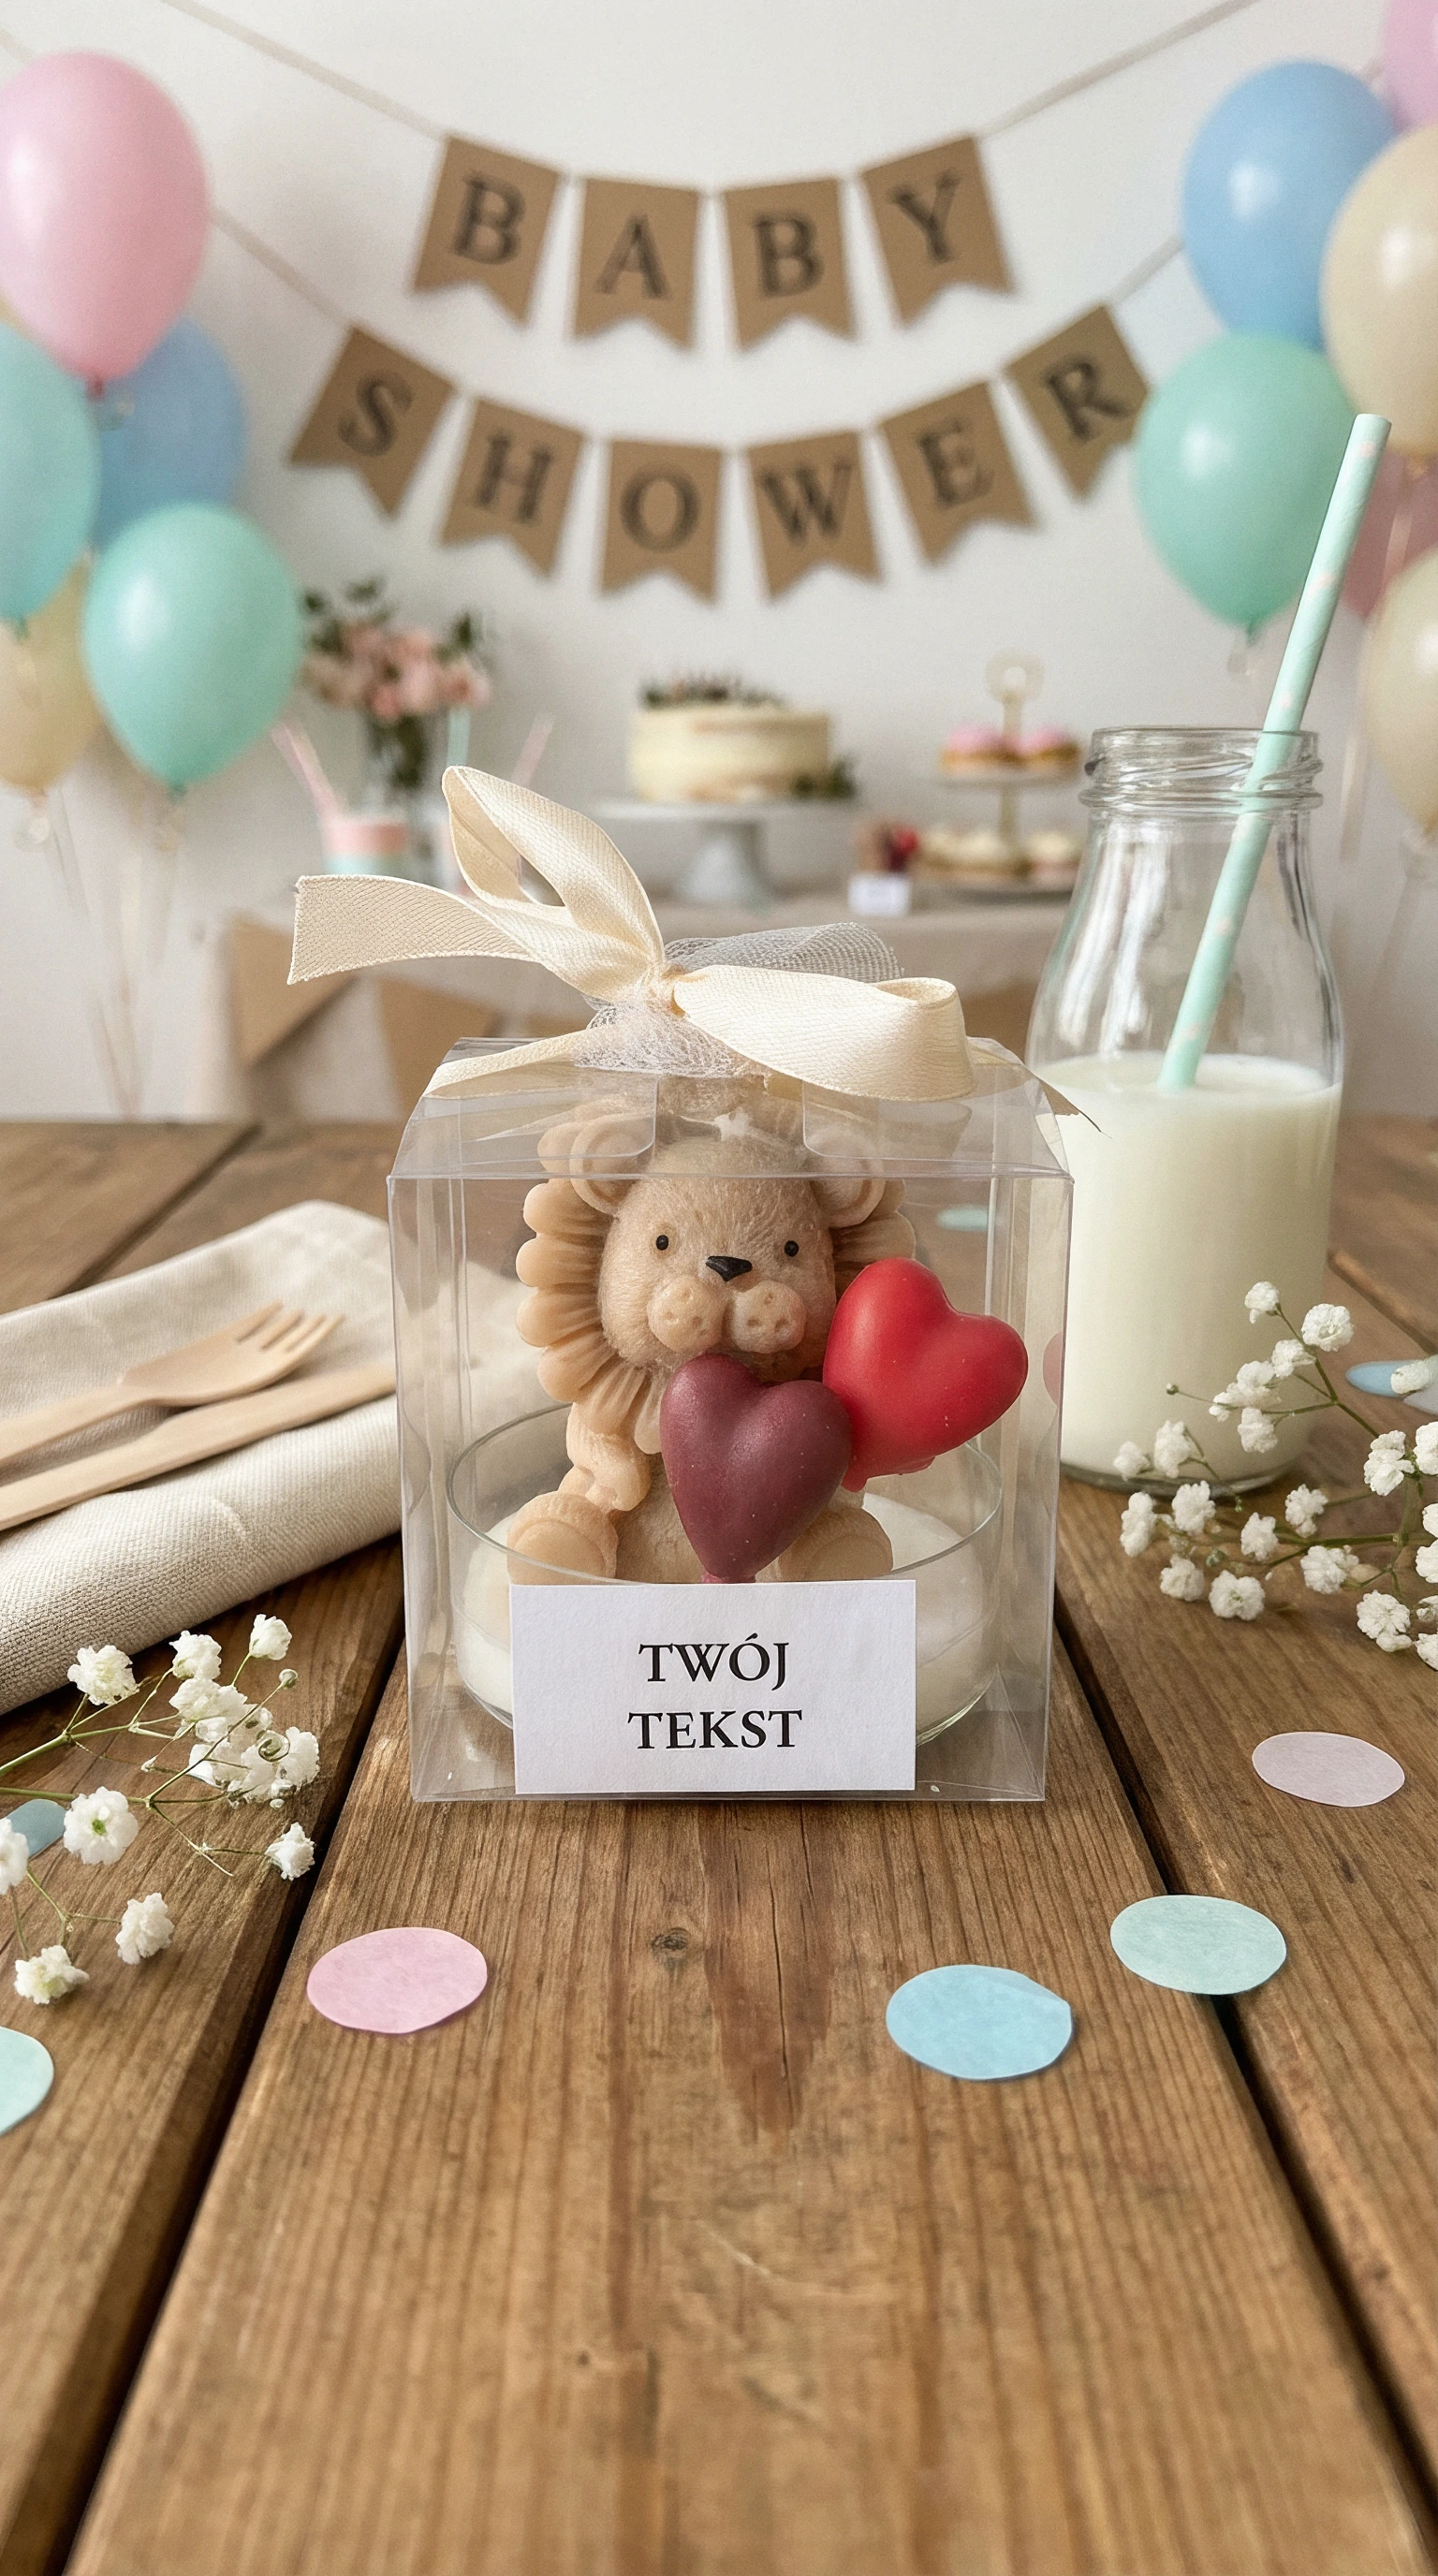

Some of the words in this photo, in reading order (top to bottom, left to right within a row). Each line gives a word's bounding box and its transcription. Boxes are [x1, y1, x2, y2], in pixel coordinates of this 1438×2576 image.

[450, 172, 961, 300] BABY
[339, 356, 1132, 551] SHOWER
[638, 1632, 790, 1691] TWÓJ
[627, 1709, 802, 1749] TEKST
